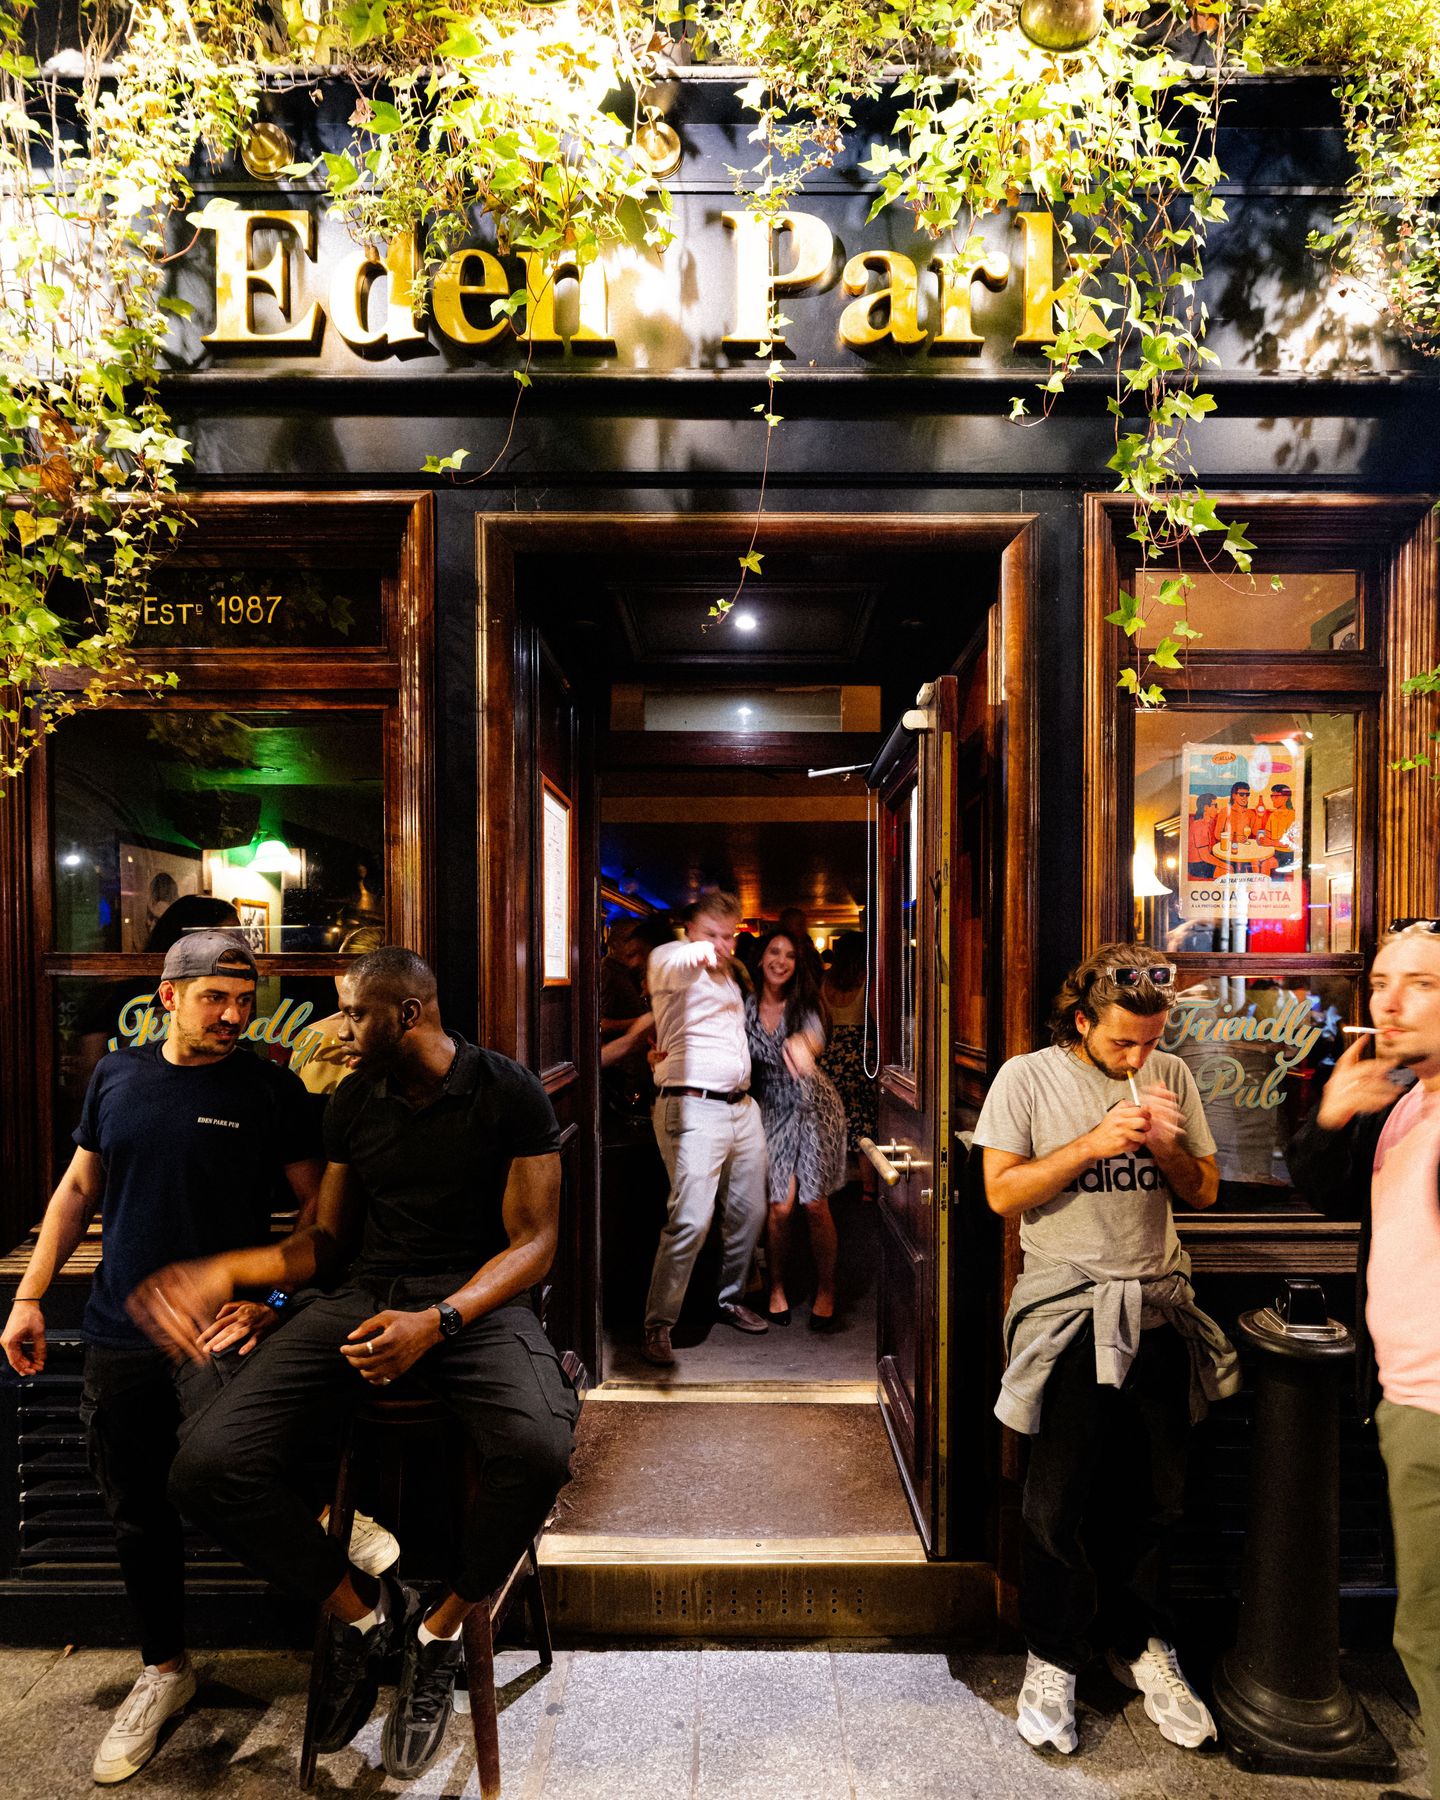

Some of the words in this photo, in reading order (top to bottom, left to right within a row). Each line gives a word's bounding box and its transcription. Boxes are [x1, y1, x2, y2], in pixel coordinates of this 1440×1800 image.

[200, 209, 614, 346] Eden
[721, 210, 1116, 346] Park
[217, 595, 283, 624] 1987
[107, 993, 324, 1072] Frdly
[1158, 998, 1322, 1068] Friendly
[1196, 1055, 1288, 1110] Pub
